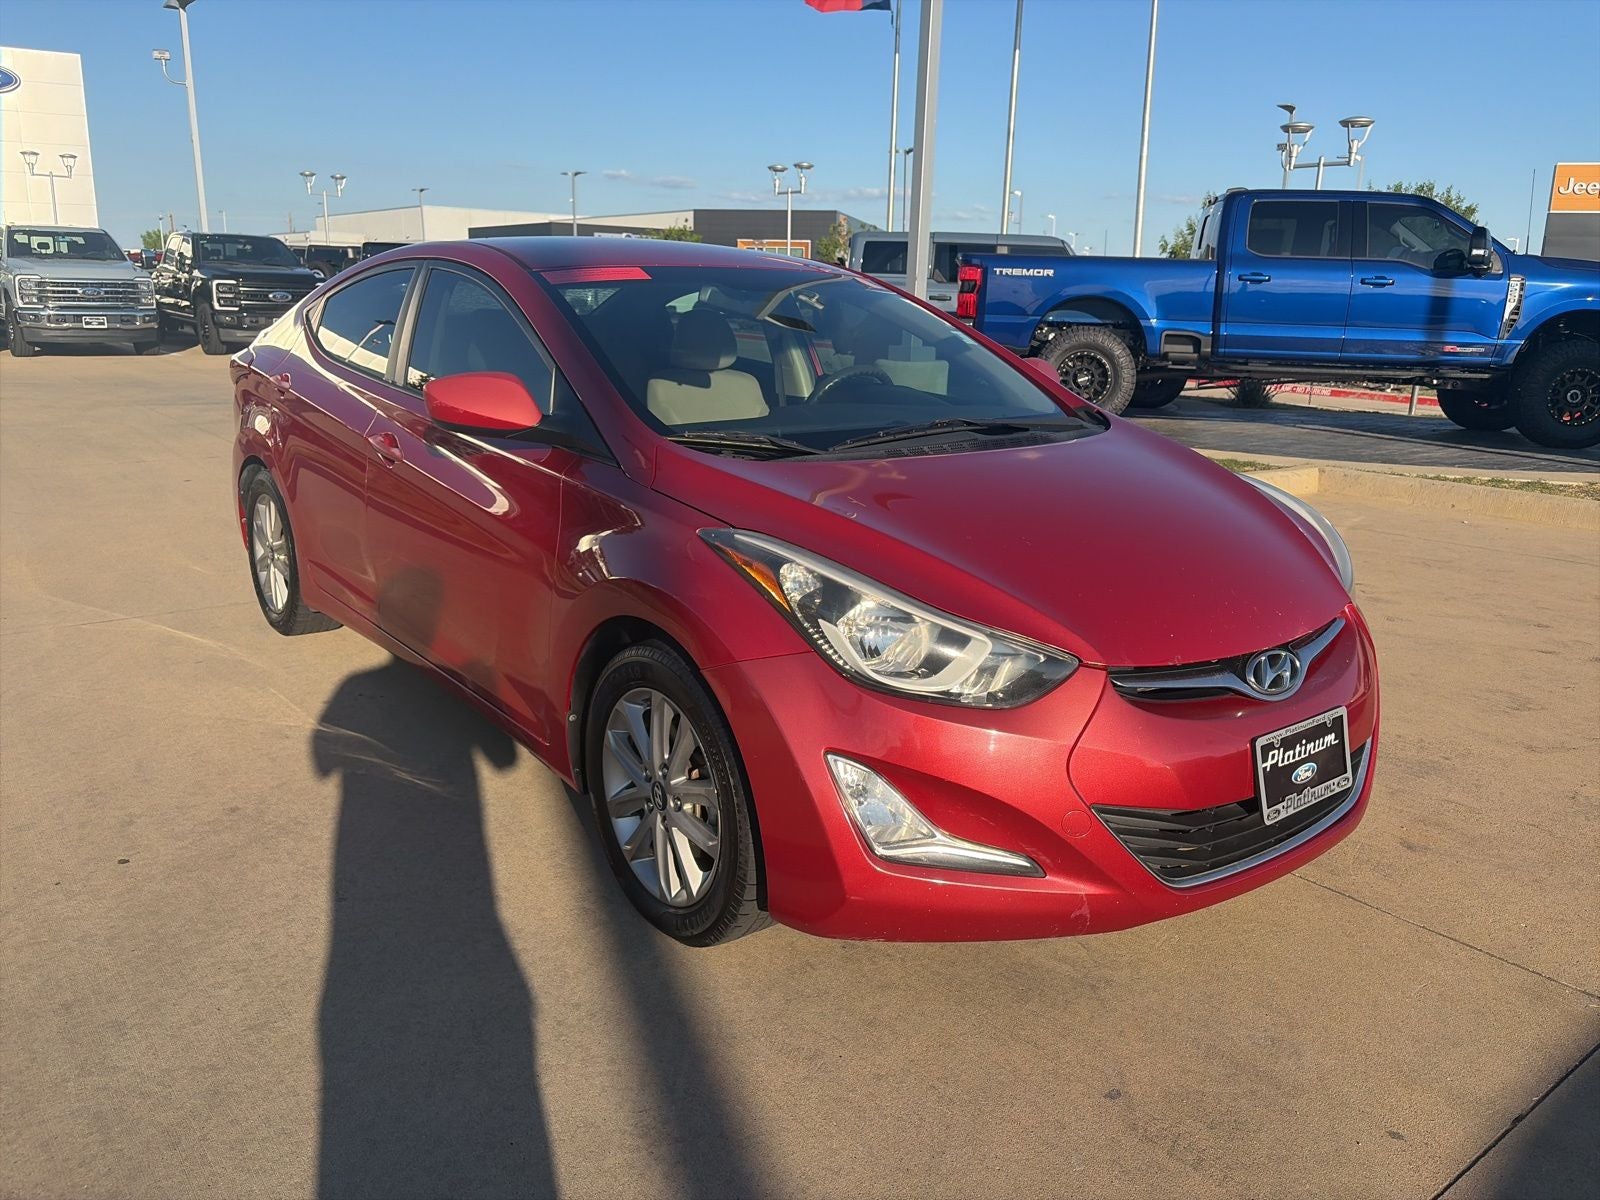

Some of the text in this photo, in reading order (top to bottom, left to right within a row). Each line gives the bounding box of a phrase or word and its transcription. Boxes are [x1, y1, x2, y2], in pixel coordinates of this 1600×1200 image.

[1557, 176, 1600, 199] Jee
[993, 267, 1055, 277] TREMOR
[1305, 386, 1332, 396] PRKING
[1262, 732, 1339, 772] Platinum
[1296, 766, 1314, 782] Ford
[1284, 784, 1335, 814] Platinum
